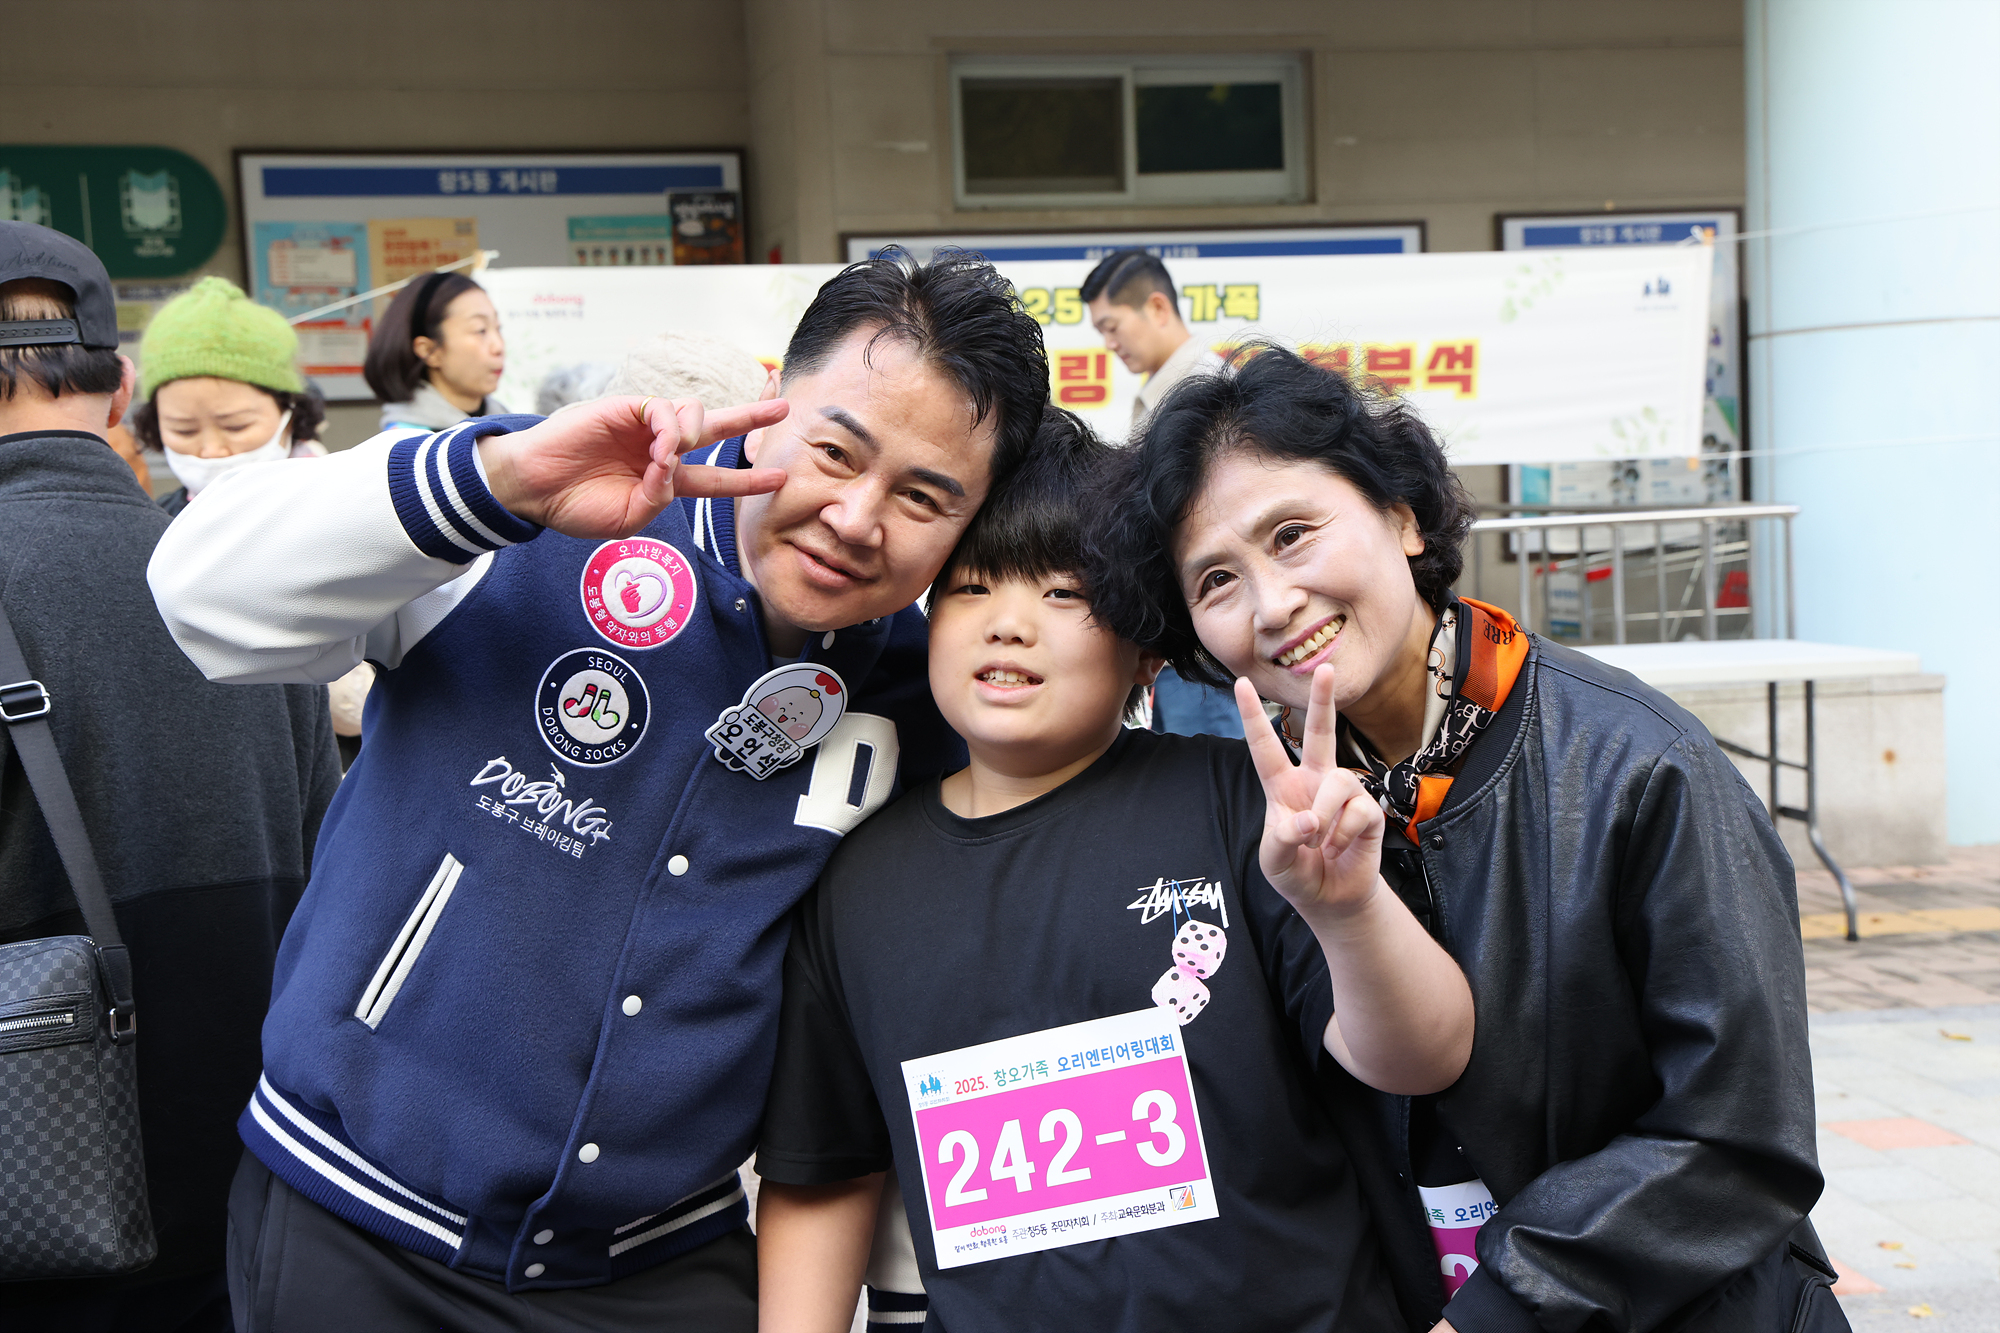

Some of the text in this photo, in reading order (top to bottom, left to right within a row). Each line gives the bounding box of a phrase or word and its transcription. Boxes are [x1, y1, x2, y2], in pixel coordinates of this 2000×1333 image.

[605, 620, 652, 643] 약자와의
[654, 617, 678, 638] 동행
[588, 656, 628, 683] SEOUL
[542, 706, 627, 760] DOBONG SOCKS
[742, 713, 793, 754] 도봉구청장
[470, 756, 607, 836] DOBONG
[475, 795, 586, 859] 도봉구 브레이킹팀
[955, 1033, 1176, 1095] 2025. 창오가족 오리엔티어링대회
[937, 1088, 1187, 1208] 242-3
[970, 1225, 1007, 1238] dobong
[1051, 1215, 1090, 1233] 주민자치회
